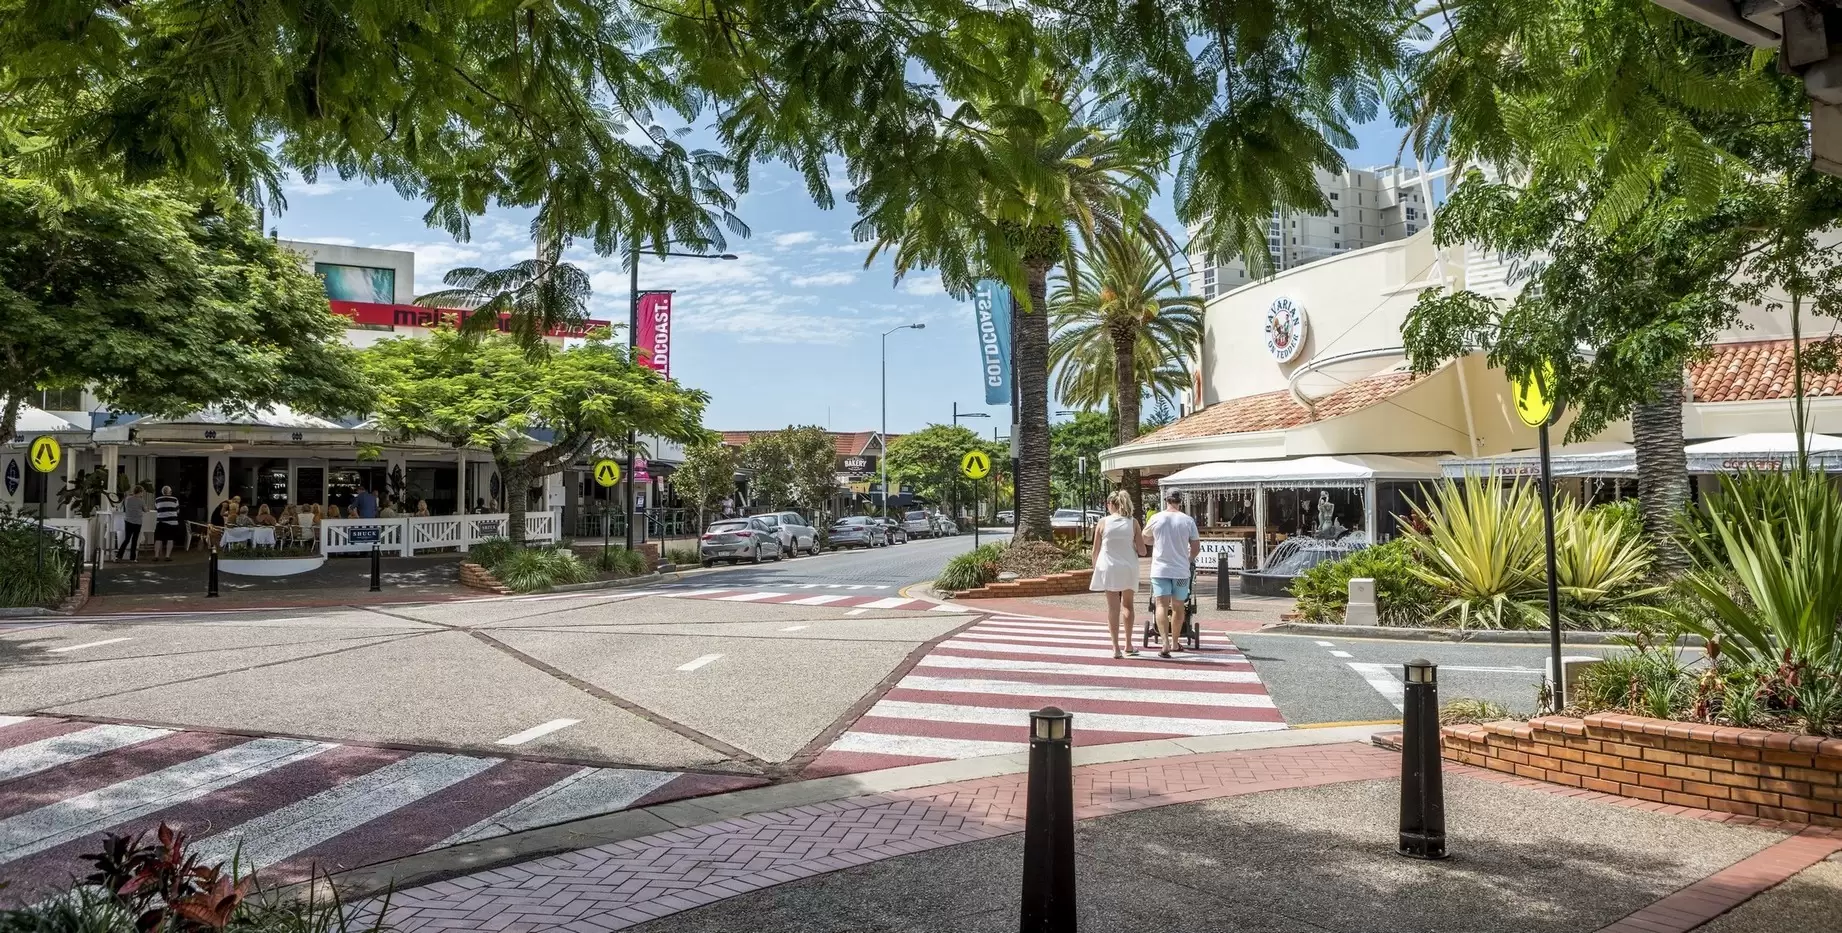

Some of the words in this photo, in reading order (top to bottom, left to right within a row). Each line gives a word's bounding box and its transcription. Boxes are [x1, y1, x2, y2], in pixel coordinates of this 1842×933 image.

[1265, 299, 1300, 333] BAVARIAN
[653, 299, 669, 382] LDCOAST.
[1276, 334, 1299, 359] TEDDER
[844, 460, 867, 468] BAKERY
[1200, 545, 1235, 553] ARIAN
